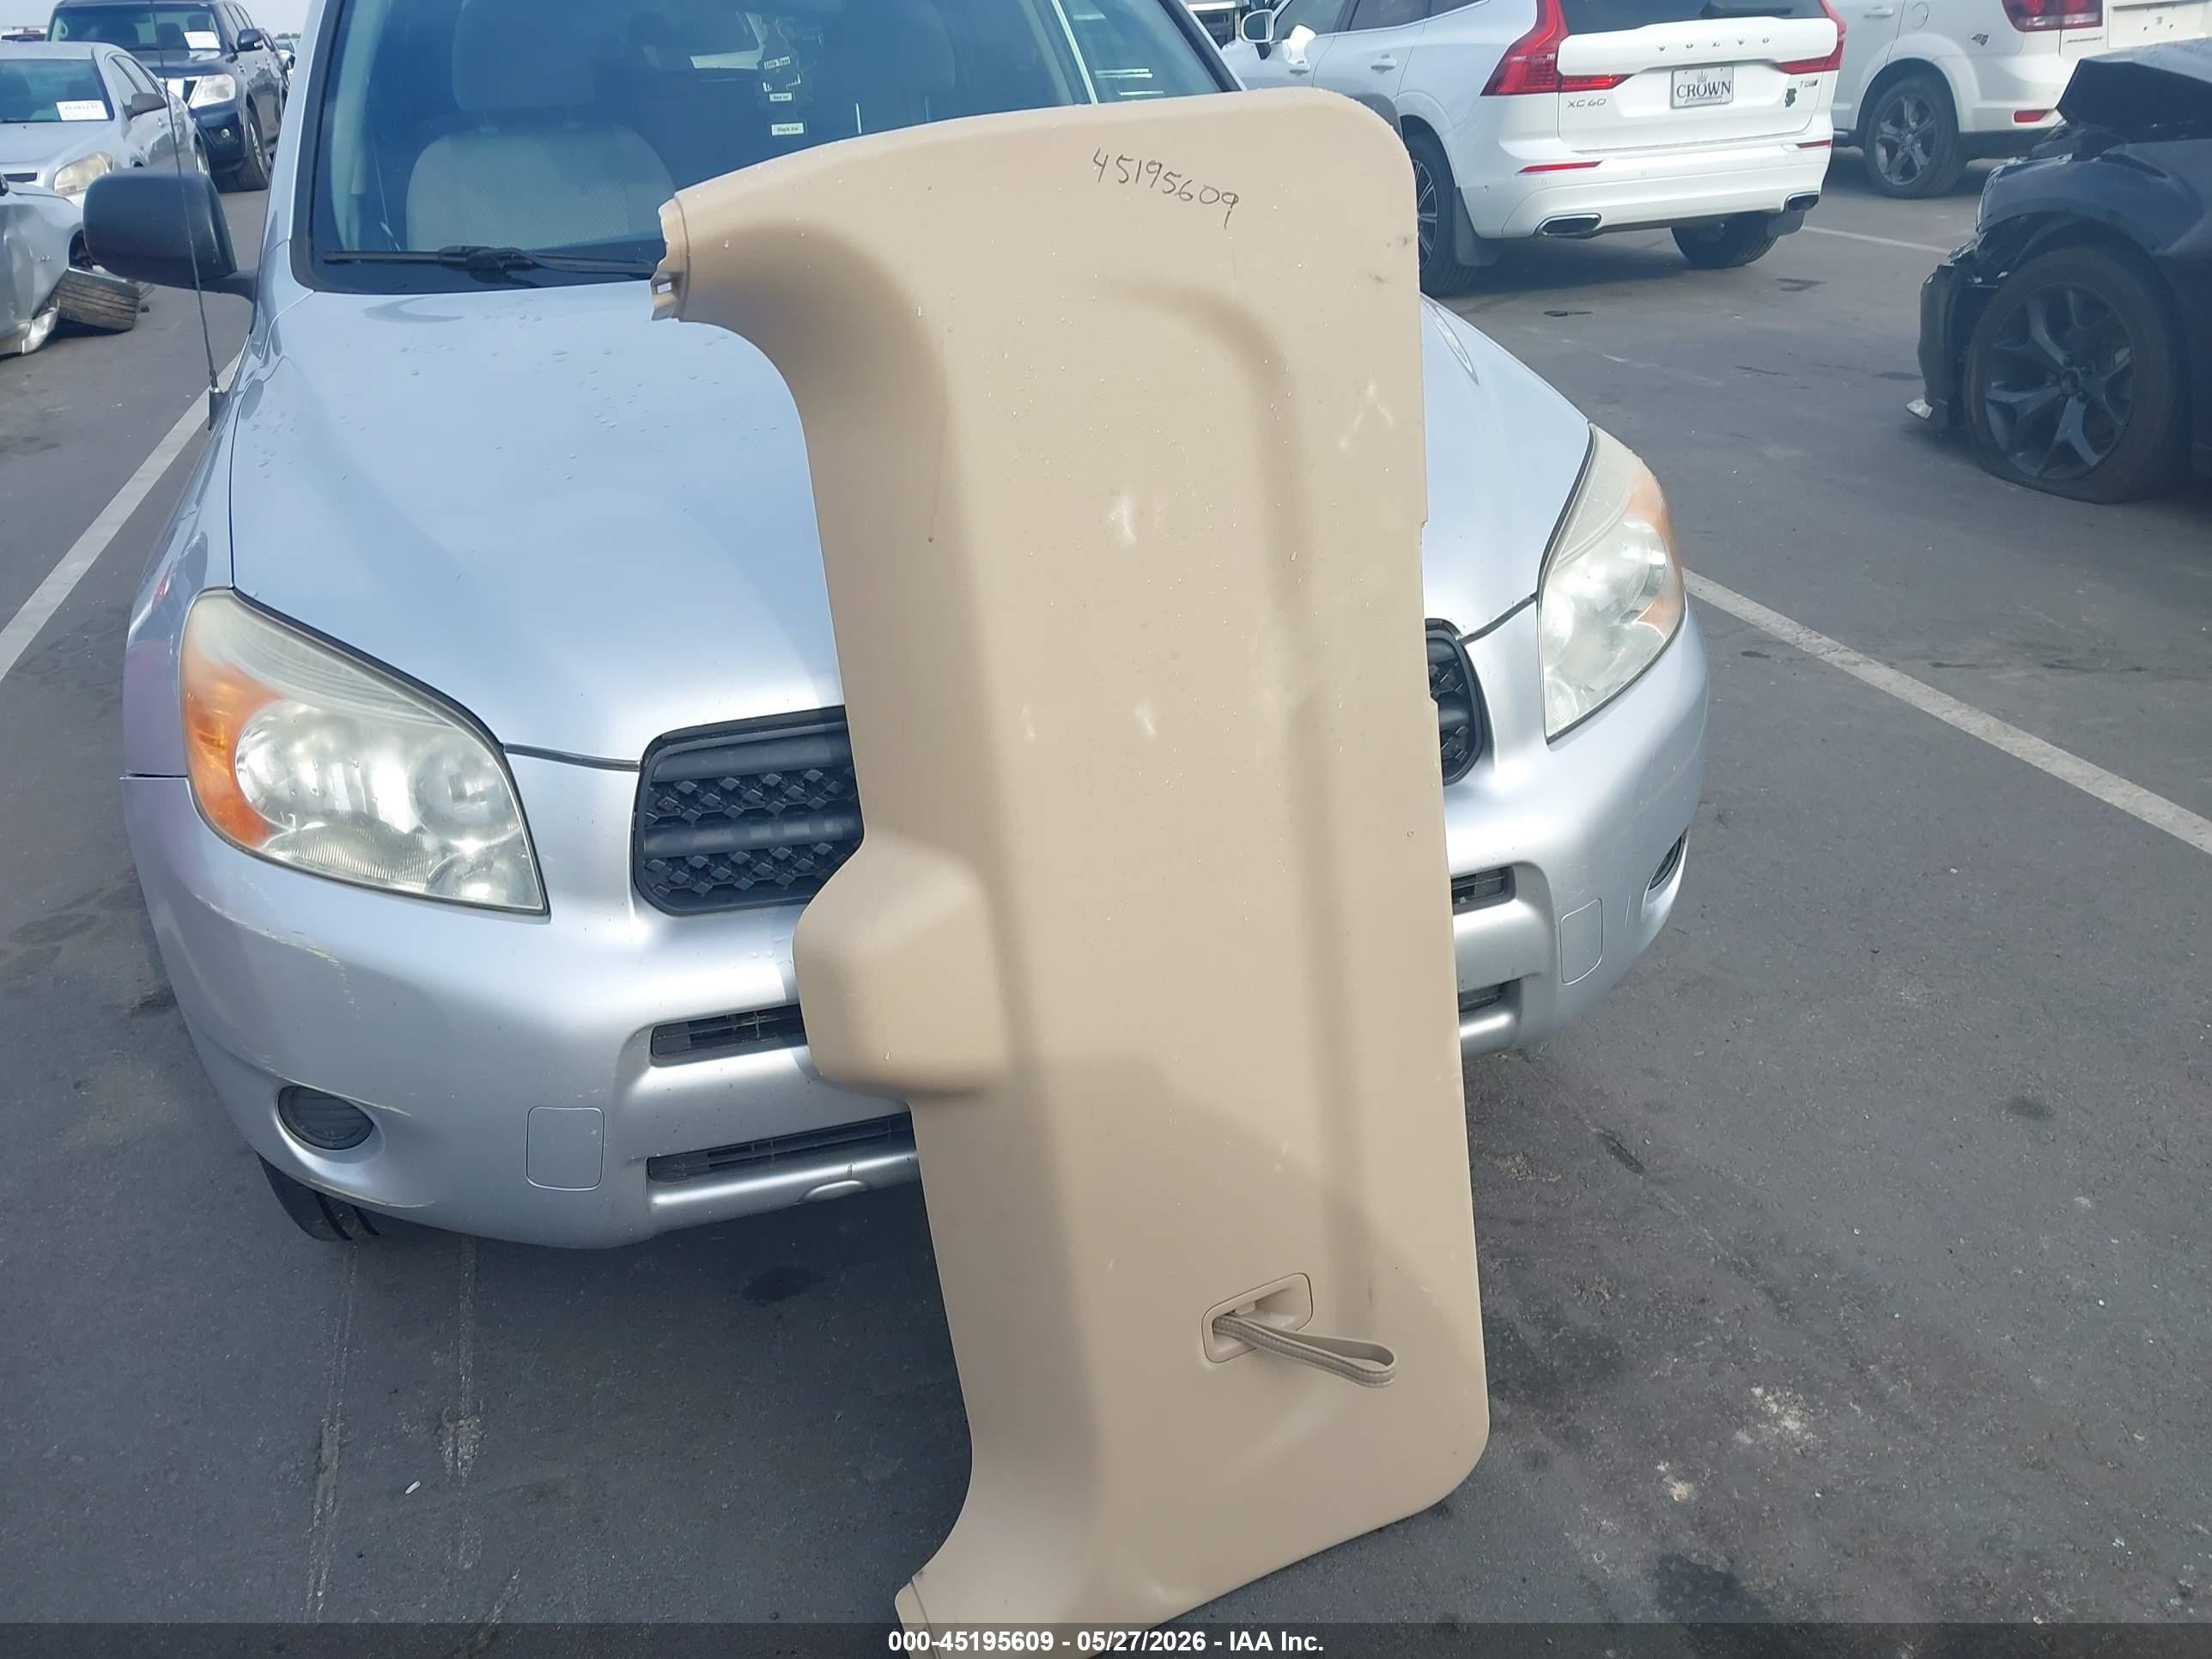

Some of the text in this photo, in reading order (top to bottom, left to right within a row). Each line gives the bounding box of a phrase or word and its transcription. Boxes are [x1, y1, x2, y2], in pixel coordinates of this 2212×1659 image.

[1676, 81, 1731, 99] CROWN
[1567, 98, 1607, 108] XC60
[1092, 147, 1239, 229] 45195609
